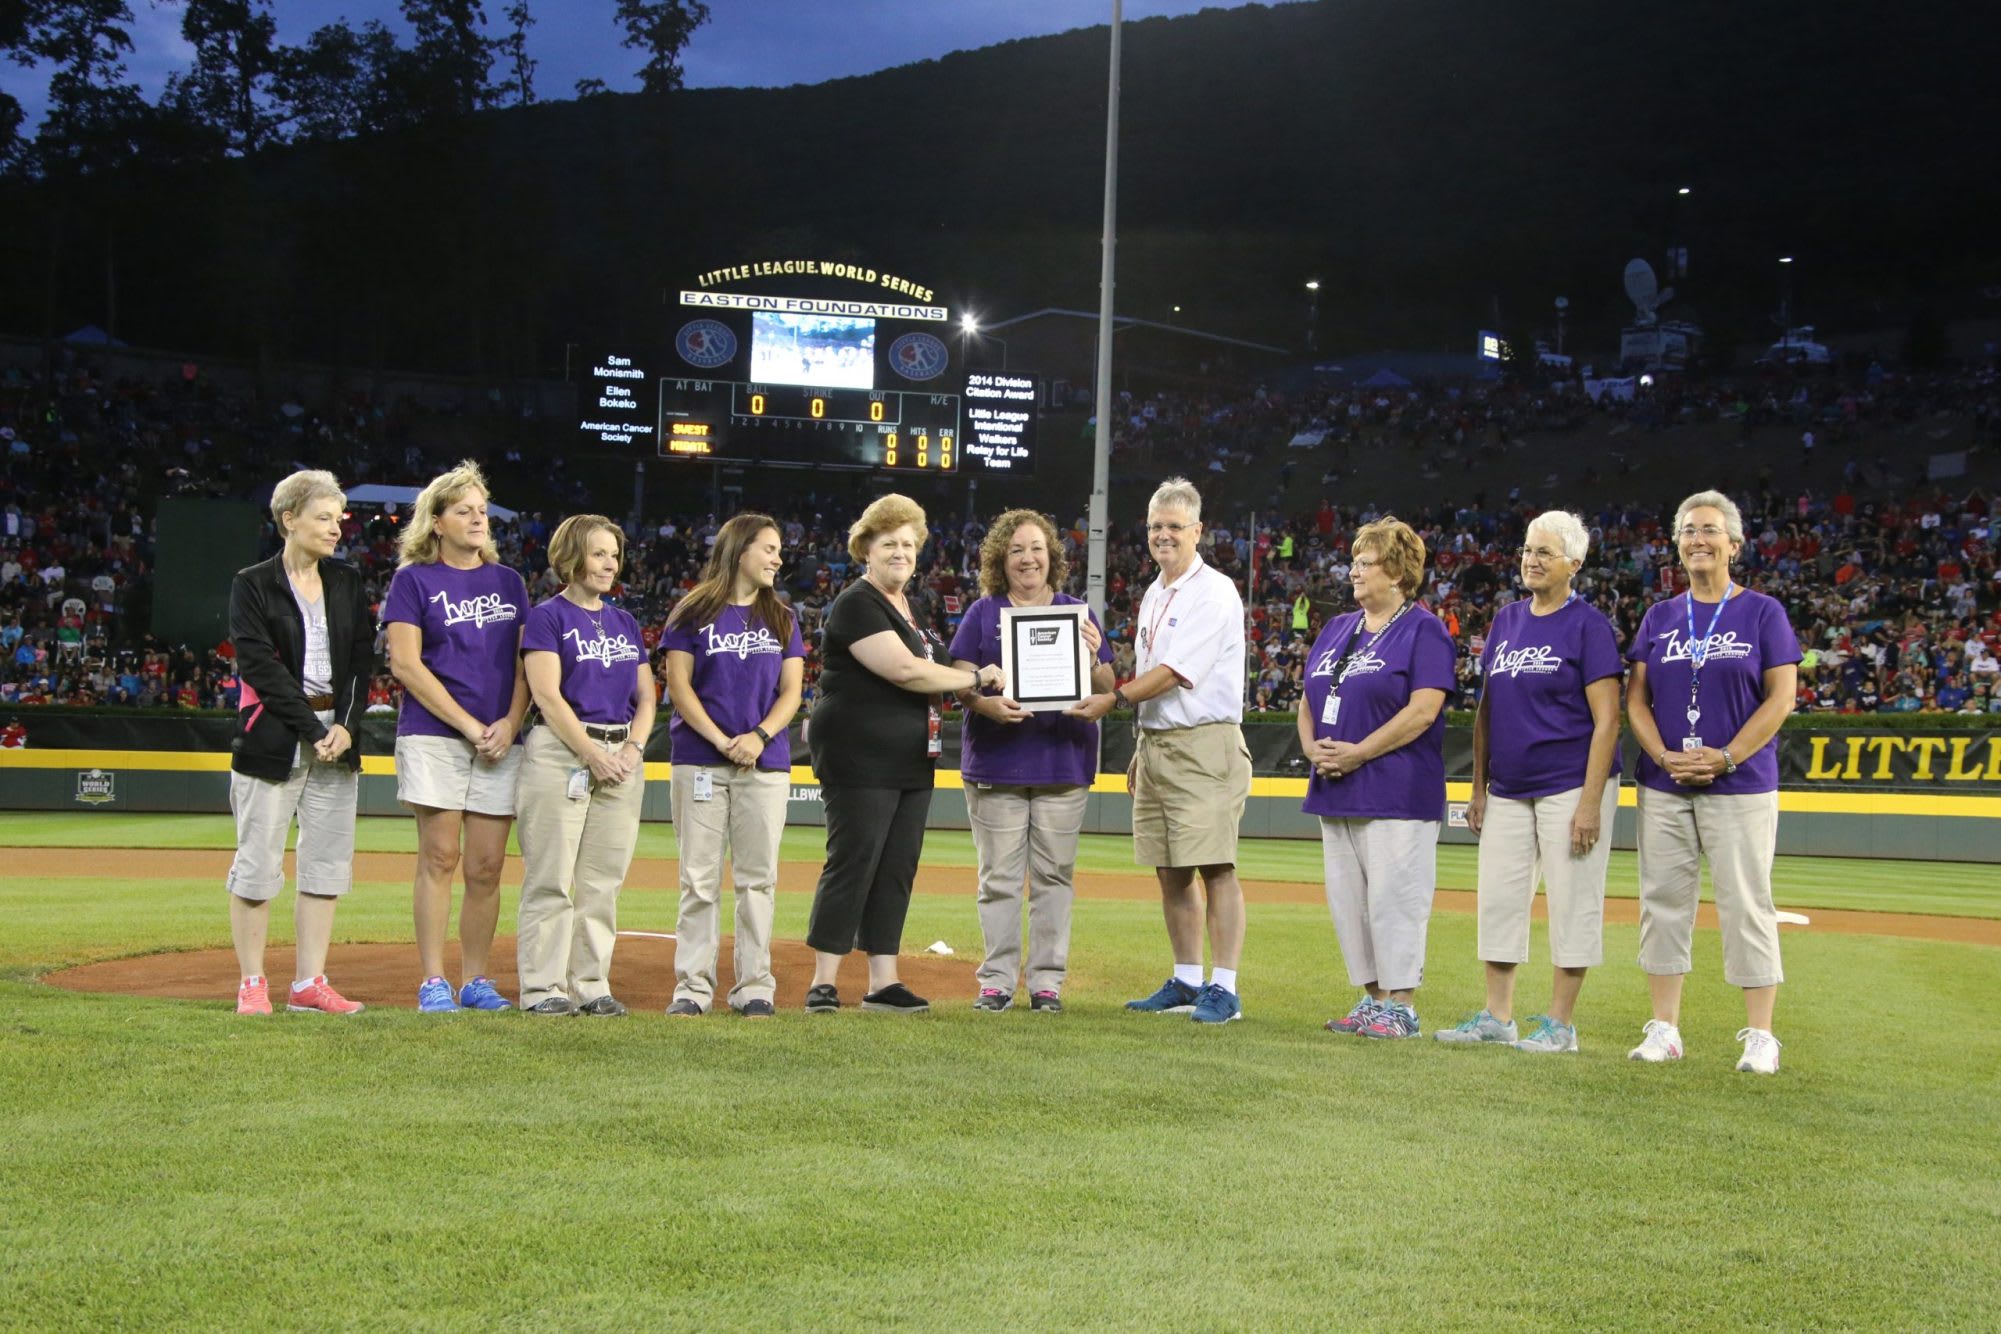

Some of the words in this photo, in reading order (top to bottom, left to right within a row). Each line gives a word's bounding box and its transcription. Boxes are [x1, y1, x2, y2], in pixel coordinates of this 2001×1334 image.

[698, 264, 750, 287] LITTLE
[820, 261, 877, 283] WORLD
[880, 274, 934, 302] SERIES
[684, 293, 778, 309] EASTON
[786, 299, 943, 319] FOUNDATIONS
[608, 355, 631, 366] Sam
[594, 367, 644, 379] Monismith
[676, 380, 688, 391] AT
[694, 381, 712, 392] BAT
[969, 375, 993, 386] 2014
[995, 377, 1032, 388] Division
[606, 386, 631, 397] Ellen
[747, 383, 769, 395] BALL
[803, 387, 833, 399] STRIKE
[966, 387, 1002, 398] Citation
[1004, 389, 1034, 400] Award
[869, 391, 886, 401] OUT
[599, 398, 637, 409] Bokeko
[752, 395, 764, 415] 0
[812, 399, 824, 418] 0
[871, 402, 883, 421] 0
[969, 408, 992, 419] Little
[994, 410, 1029, 422] League
[580, 421, 620, 432] American
[622, 423, 653, 434] Cancer
[855, 424, 863, 432] 10
[878, 425, 897, 434] RUNS
[910, 427, 927, 436] HITS
[939, 428, 954, 437] ERR
[974, 420, 1023, 432] Intentional
[601, 432, 632, 444] Society
[887, 433, 897, 448] 0
[918, 435, 928, 451] 0
[942, 437, 951, 452] 0
[979, 433, 1017, 445] Walkers
[967, 444, 994, 457] Relay
[996, 446, 1009, 456] for
[1011, 447, 1028, 457] Life
[886, 450, 896, 465] 0
[918, 452, 927, 467] 0
[941, 453, 950, 468] 0
[984, 457, 1011, 467] Team
[429, 591, 517, 629] hope
[698, 623, 783, 660] hope
[1490, 640, 1562, 678] hope
